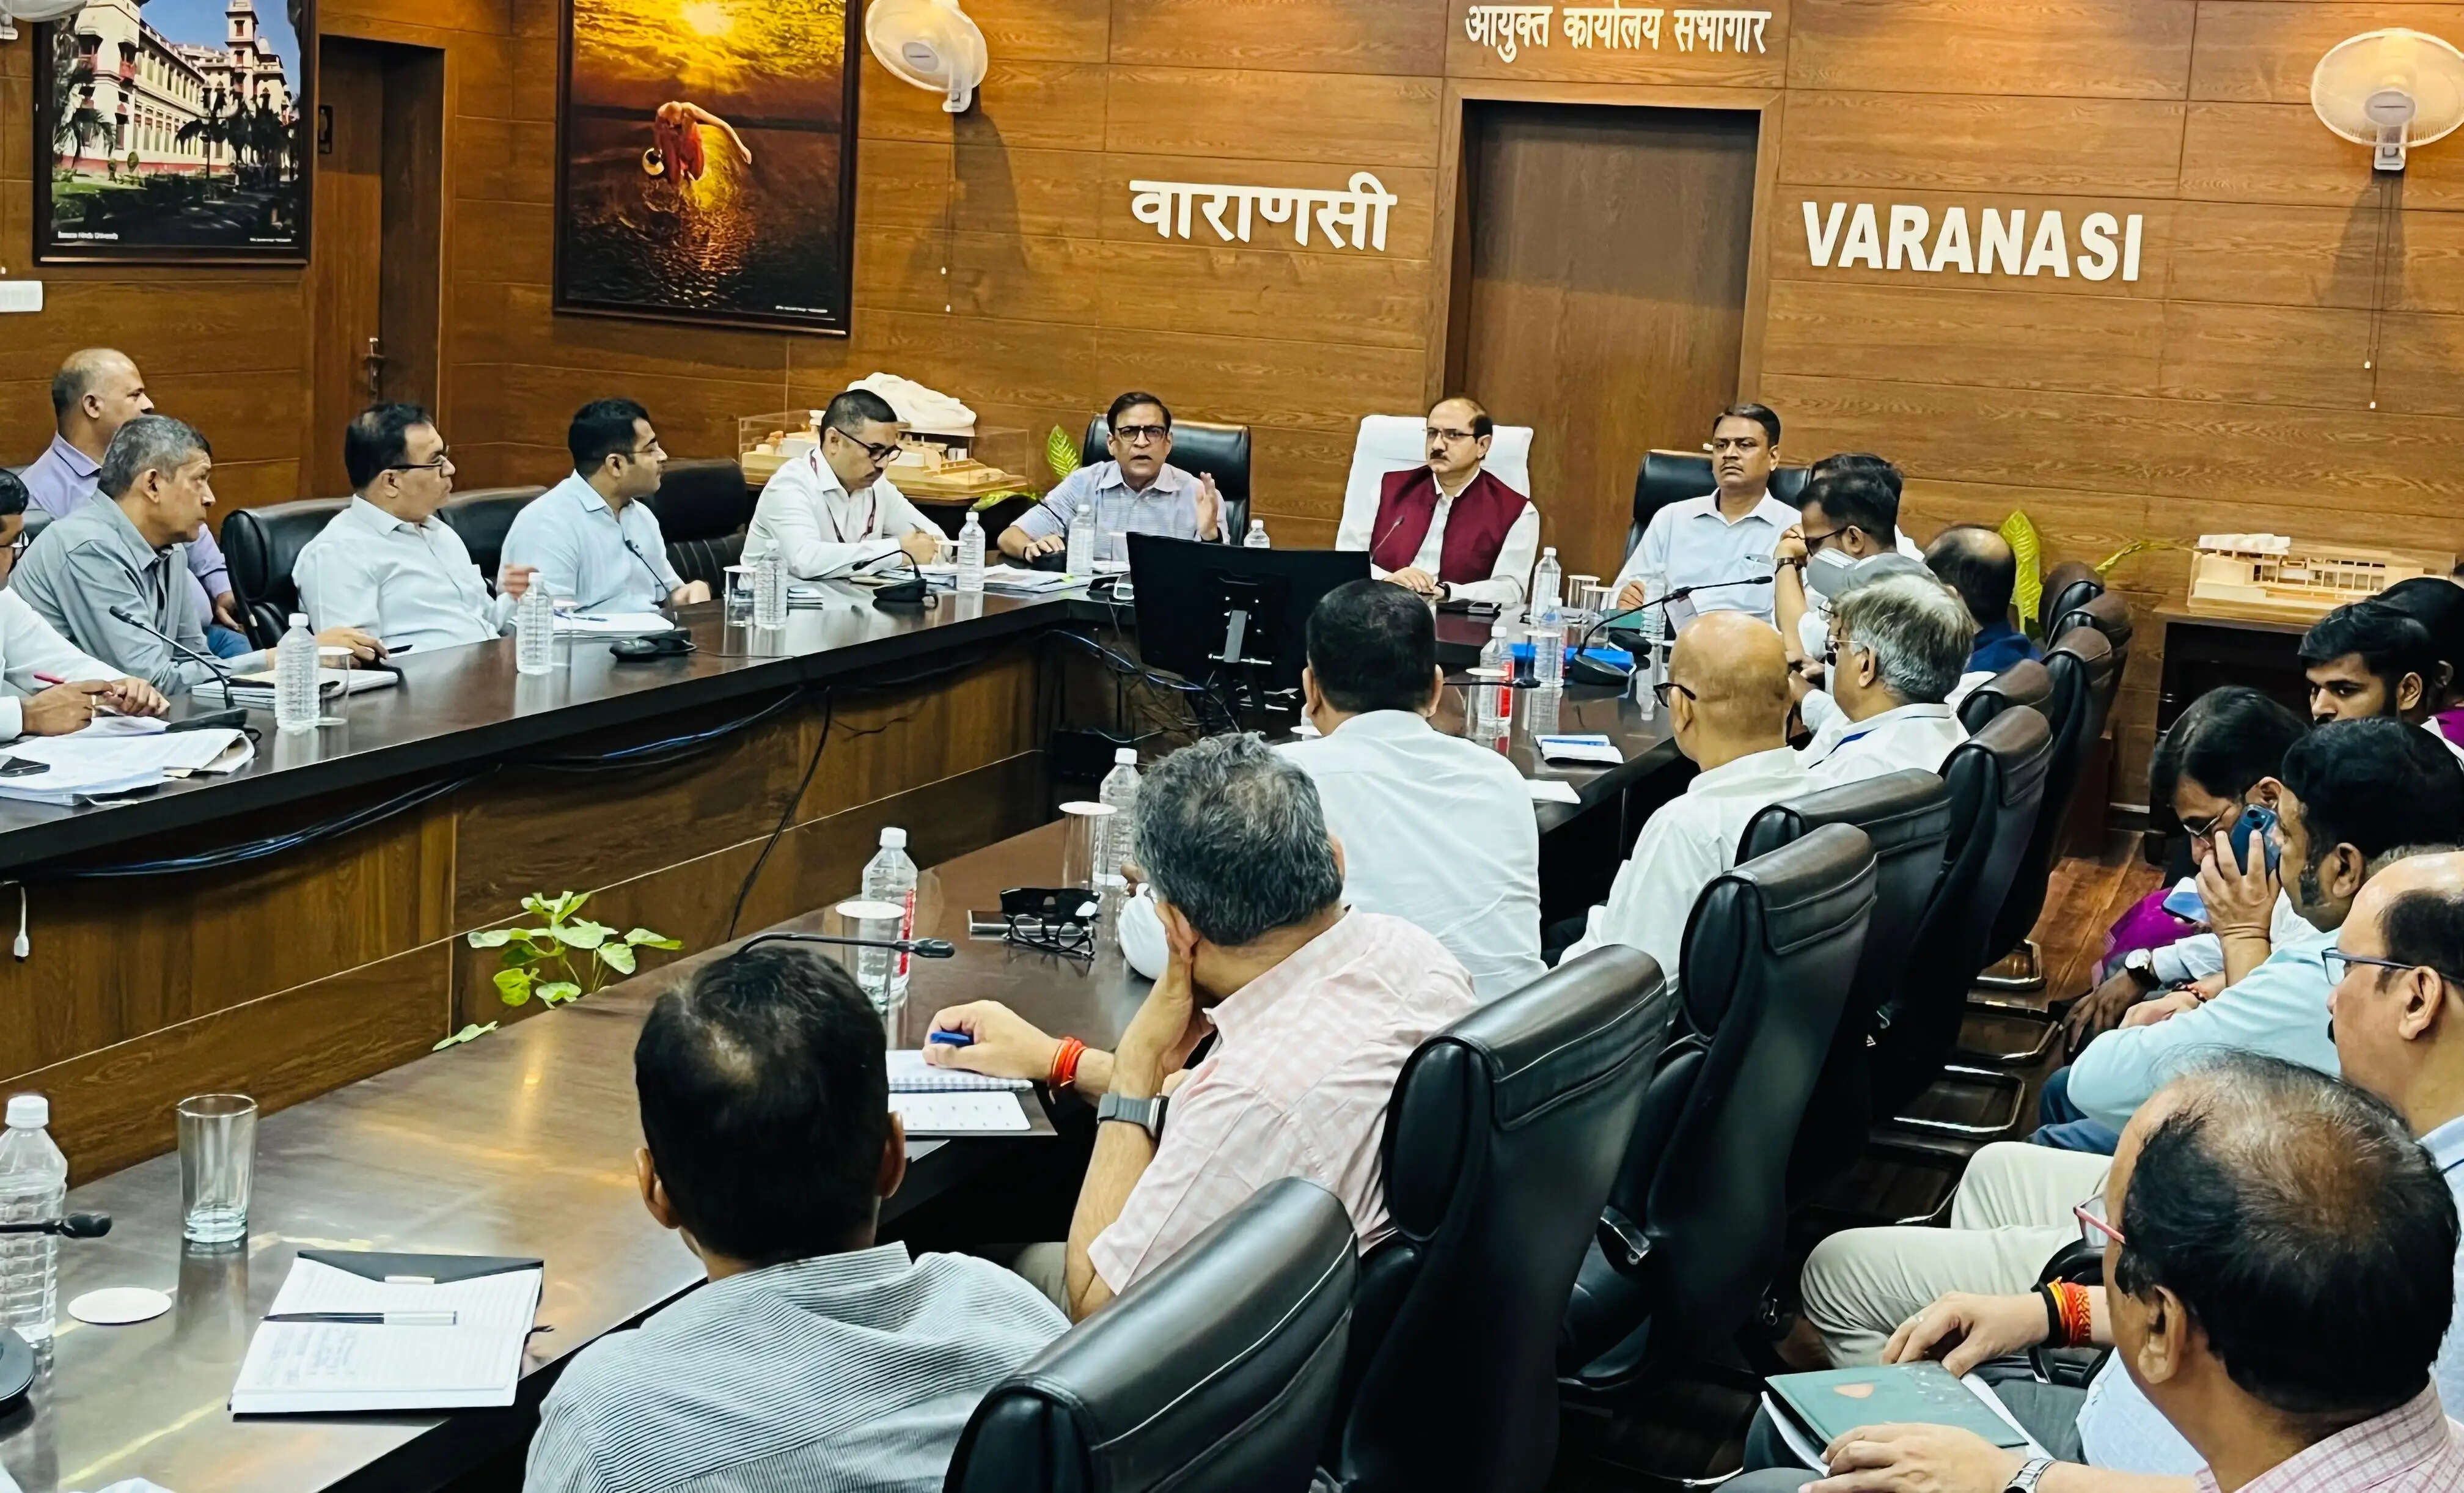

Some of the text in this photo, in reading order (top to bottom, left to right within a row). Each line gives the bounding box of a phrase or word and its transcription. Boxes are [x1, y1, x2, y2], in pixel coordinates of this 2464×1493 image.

[1465, 5, 1553, 63] आयुक्त
[1673, 9, 1772, 54] सभागार
[1129, 172, 1398, 251] वाराणसी
[1802, 201, 2143, 281] VARANASI
